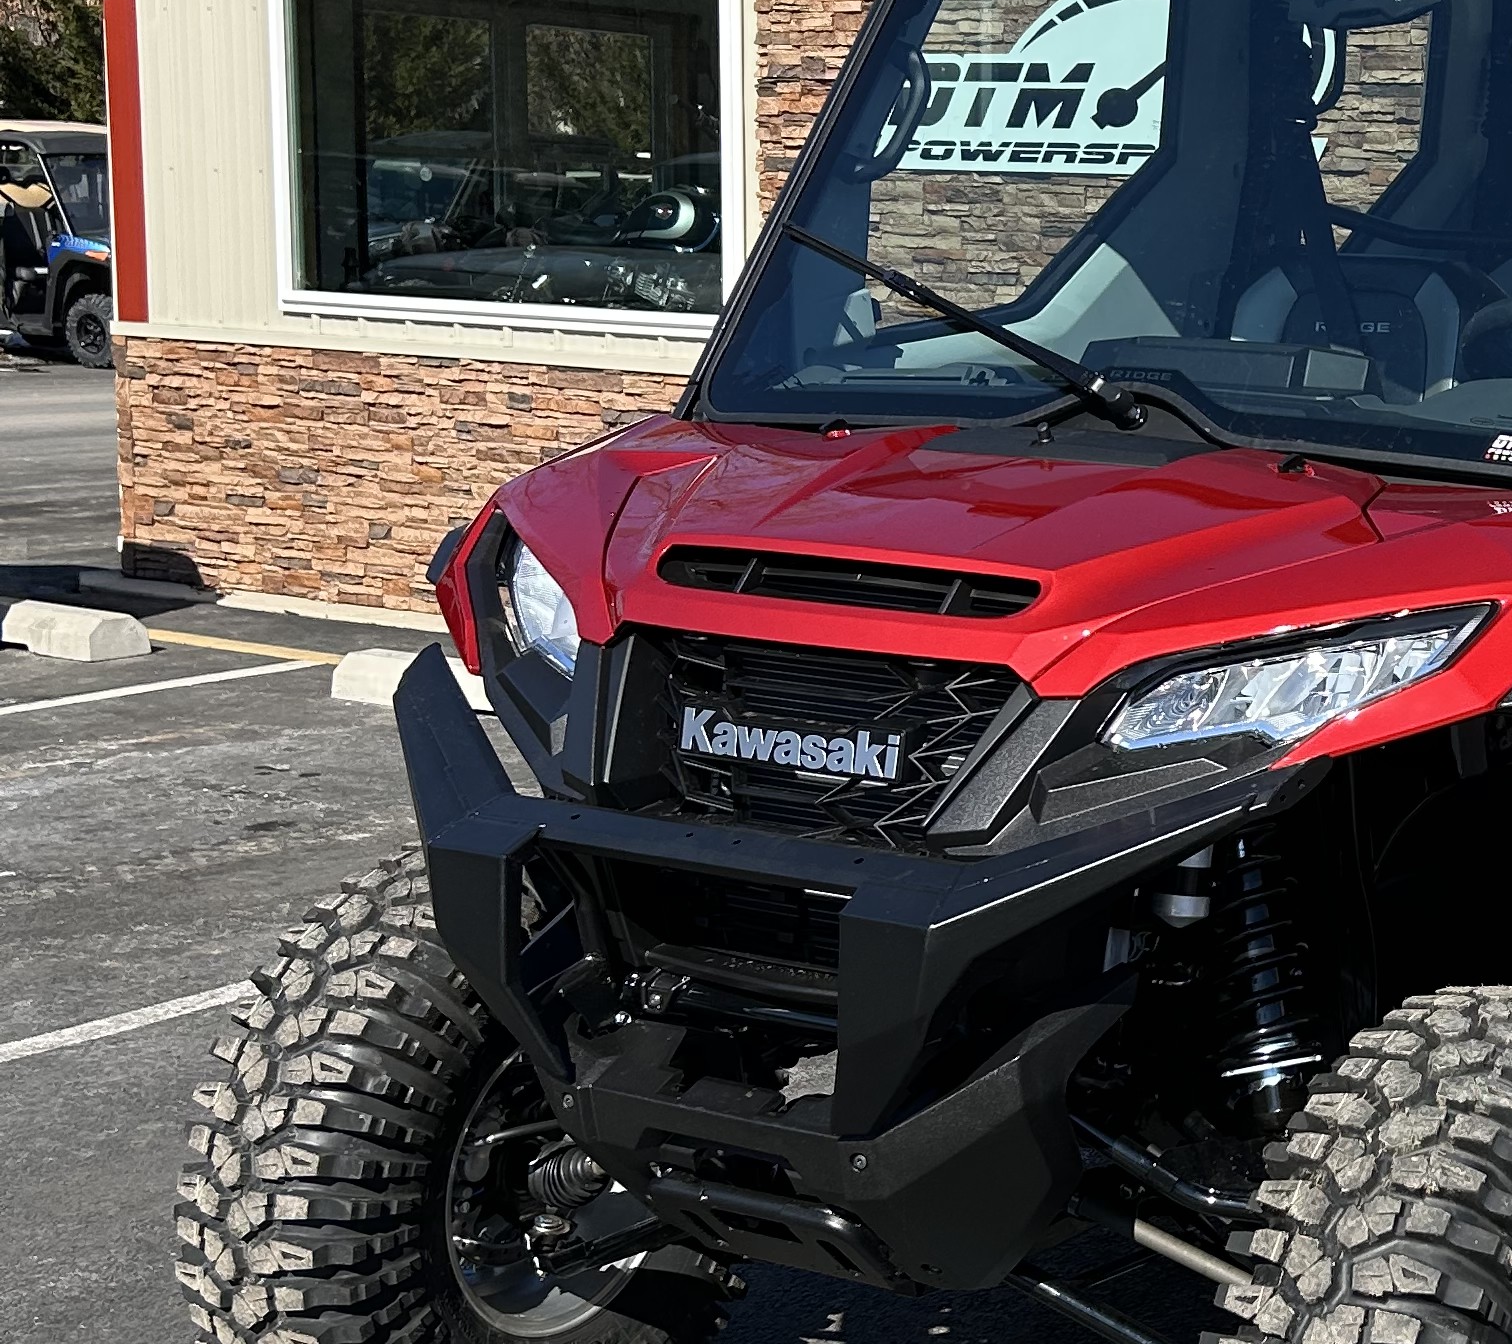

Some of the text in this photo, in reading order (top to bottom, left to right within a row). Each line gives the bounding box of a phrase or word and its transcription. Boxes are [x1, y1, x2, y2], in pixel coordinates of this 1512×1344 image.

[888, 62, 1096, 129] DTM
[1315, 321, 1391, 333] RGE
[1110, 369, 1173, 381] RIDGE
[680, 706, 902, 780] Kawasaki
